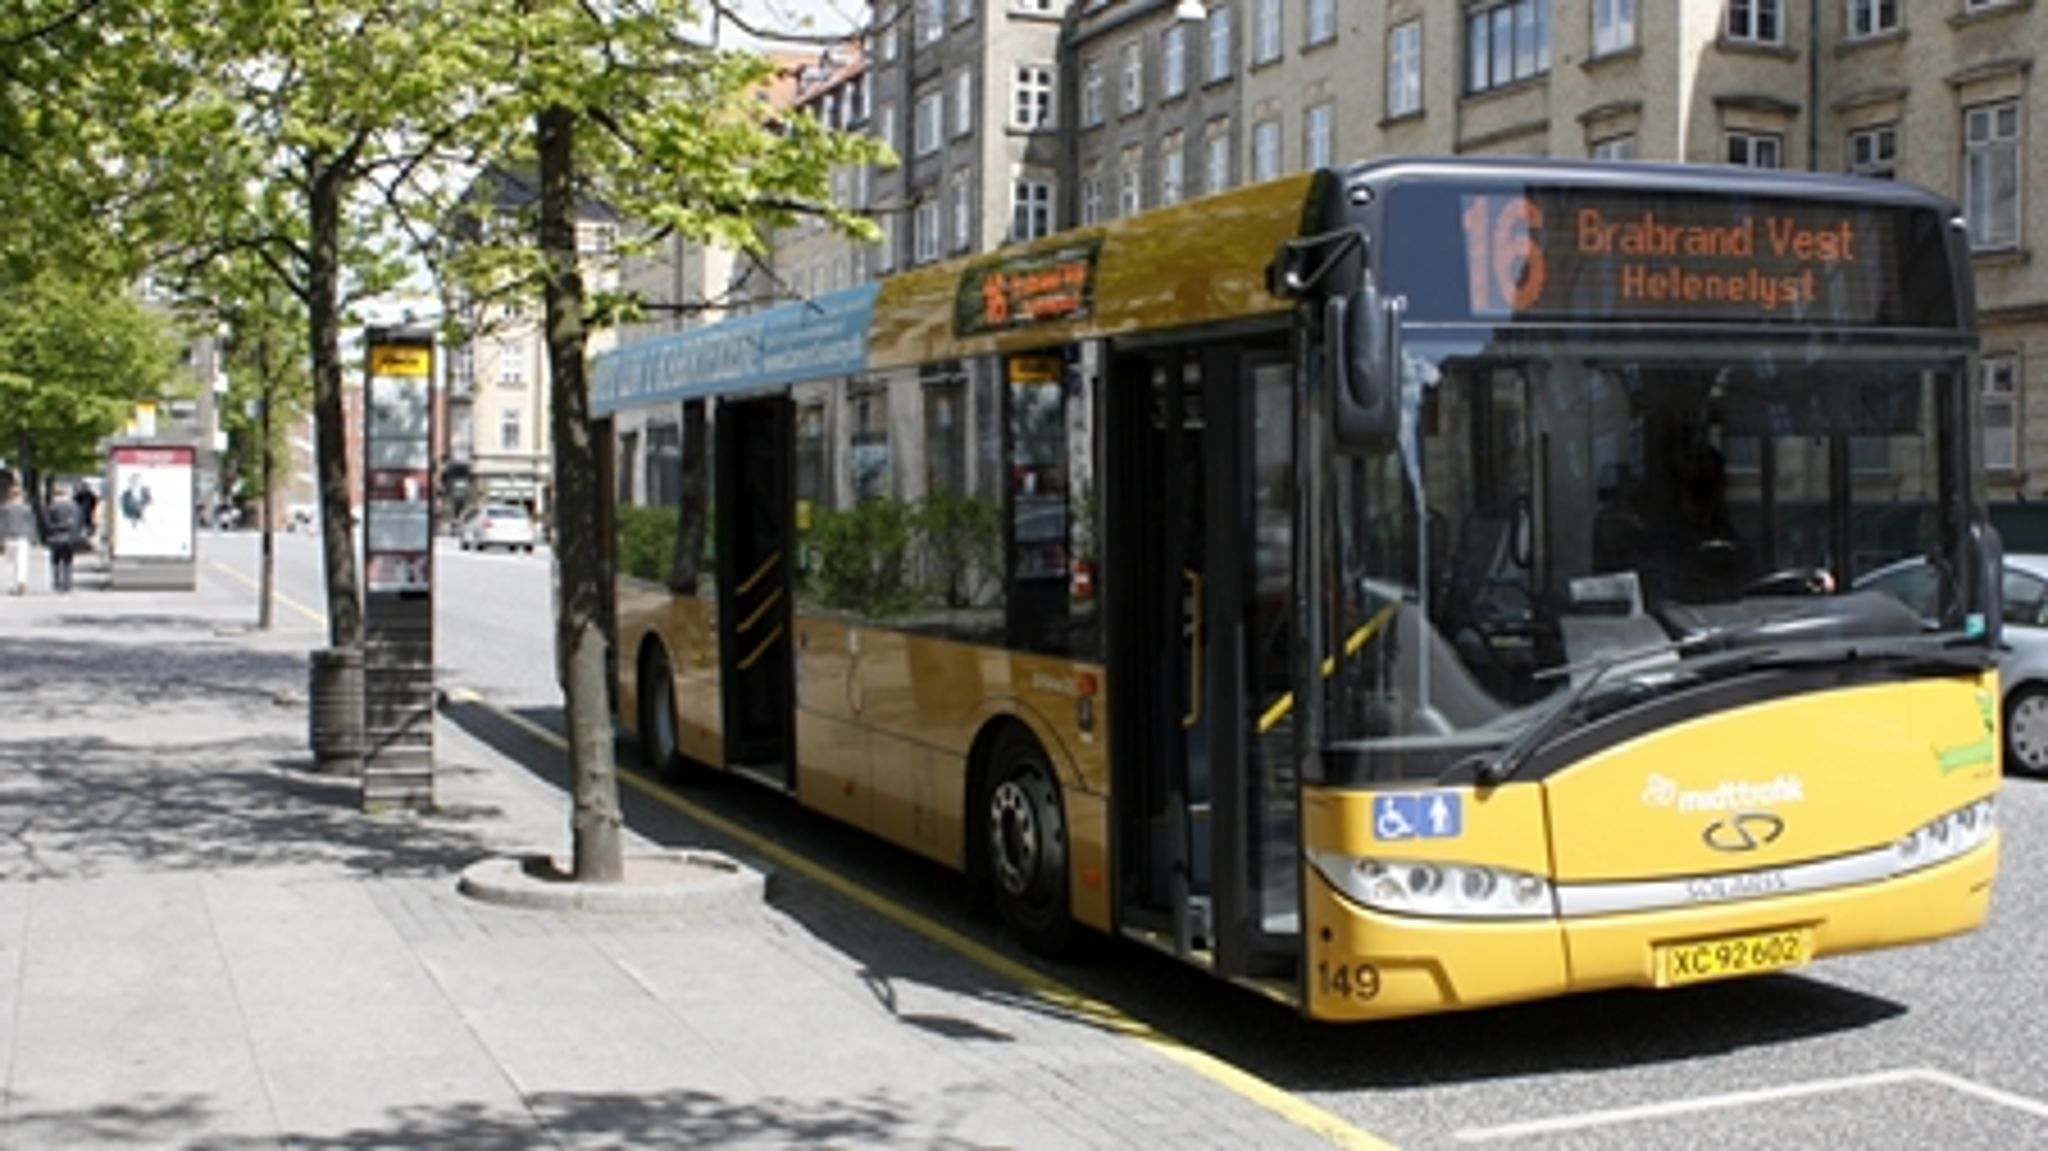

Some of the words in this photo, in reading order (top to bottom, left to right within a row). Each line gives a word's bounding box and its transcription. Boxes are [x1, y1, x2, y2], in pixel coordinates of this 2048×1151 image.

[1463, 195, 1547, 311] 16
[1576, 208, 1755, 257] Brabrand
[1764, 216, 1855, 261] Vest
[1621, 264, 1816, 310] Helenelyst
[1317, 961, 1381, 1002] 149
